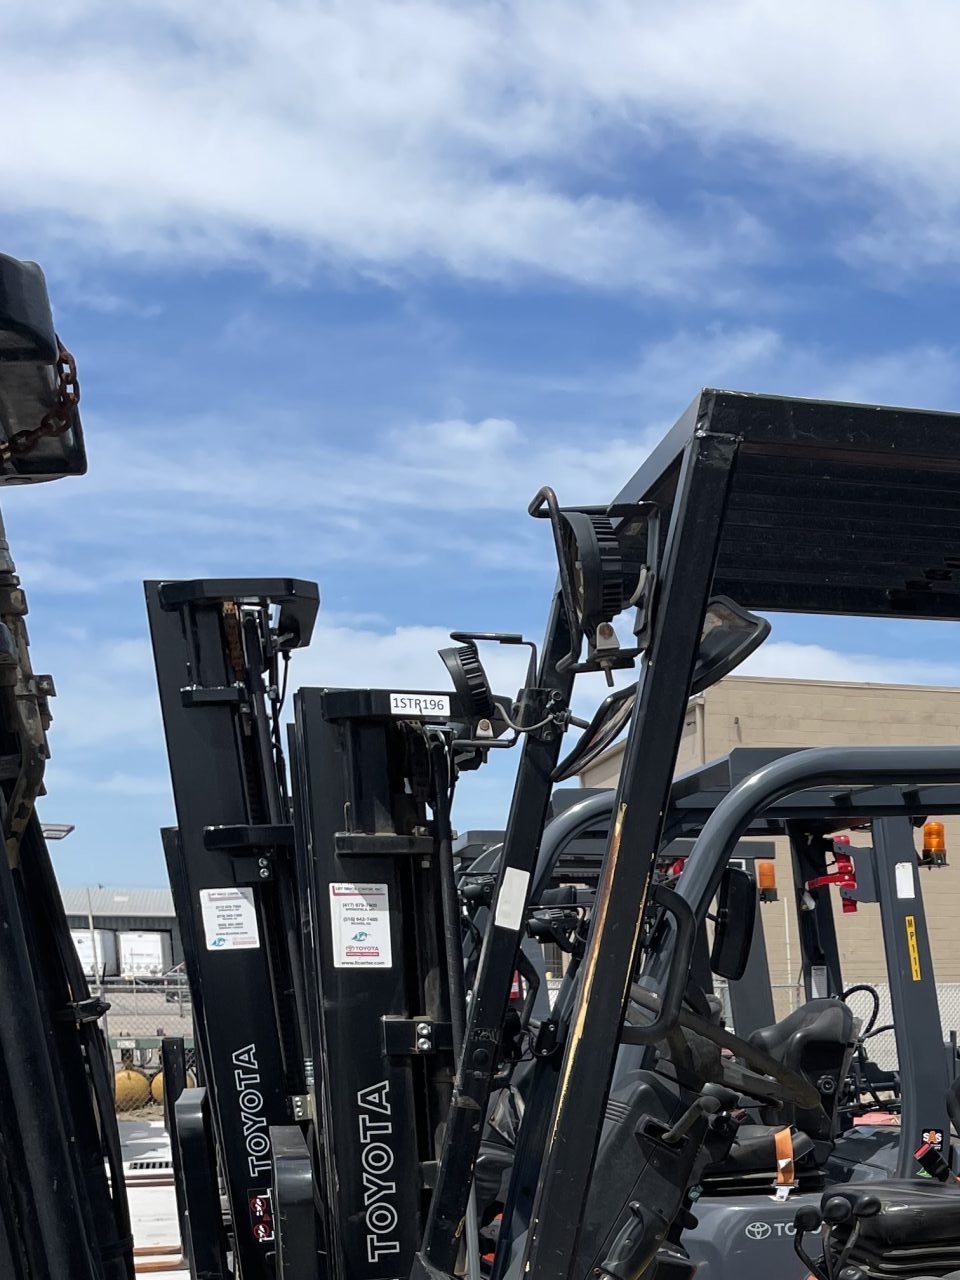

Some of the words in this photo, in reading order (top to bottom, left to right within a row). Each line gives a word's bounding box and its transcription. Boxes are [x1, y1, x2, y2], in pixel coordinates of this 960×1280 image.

[393, 697, 445, 711] 1STR196
[232, 1043, 272, 1177] TOYOTA
[922, 1130, 943, 1144] SAS
[357, 1079, 400, 1263] TOYOTA
